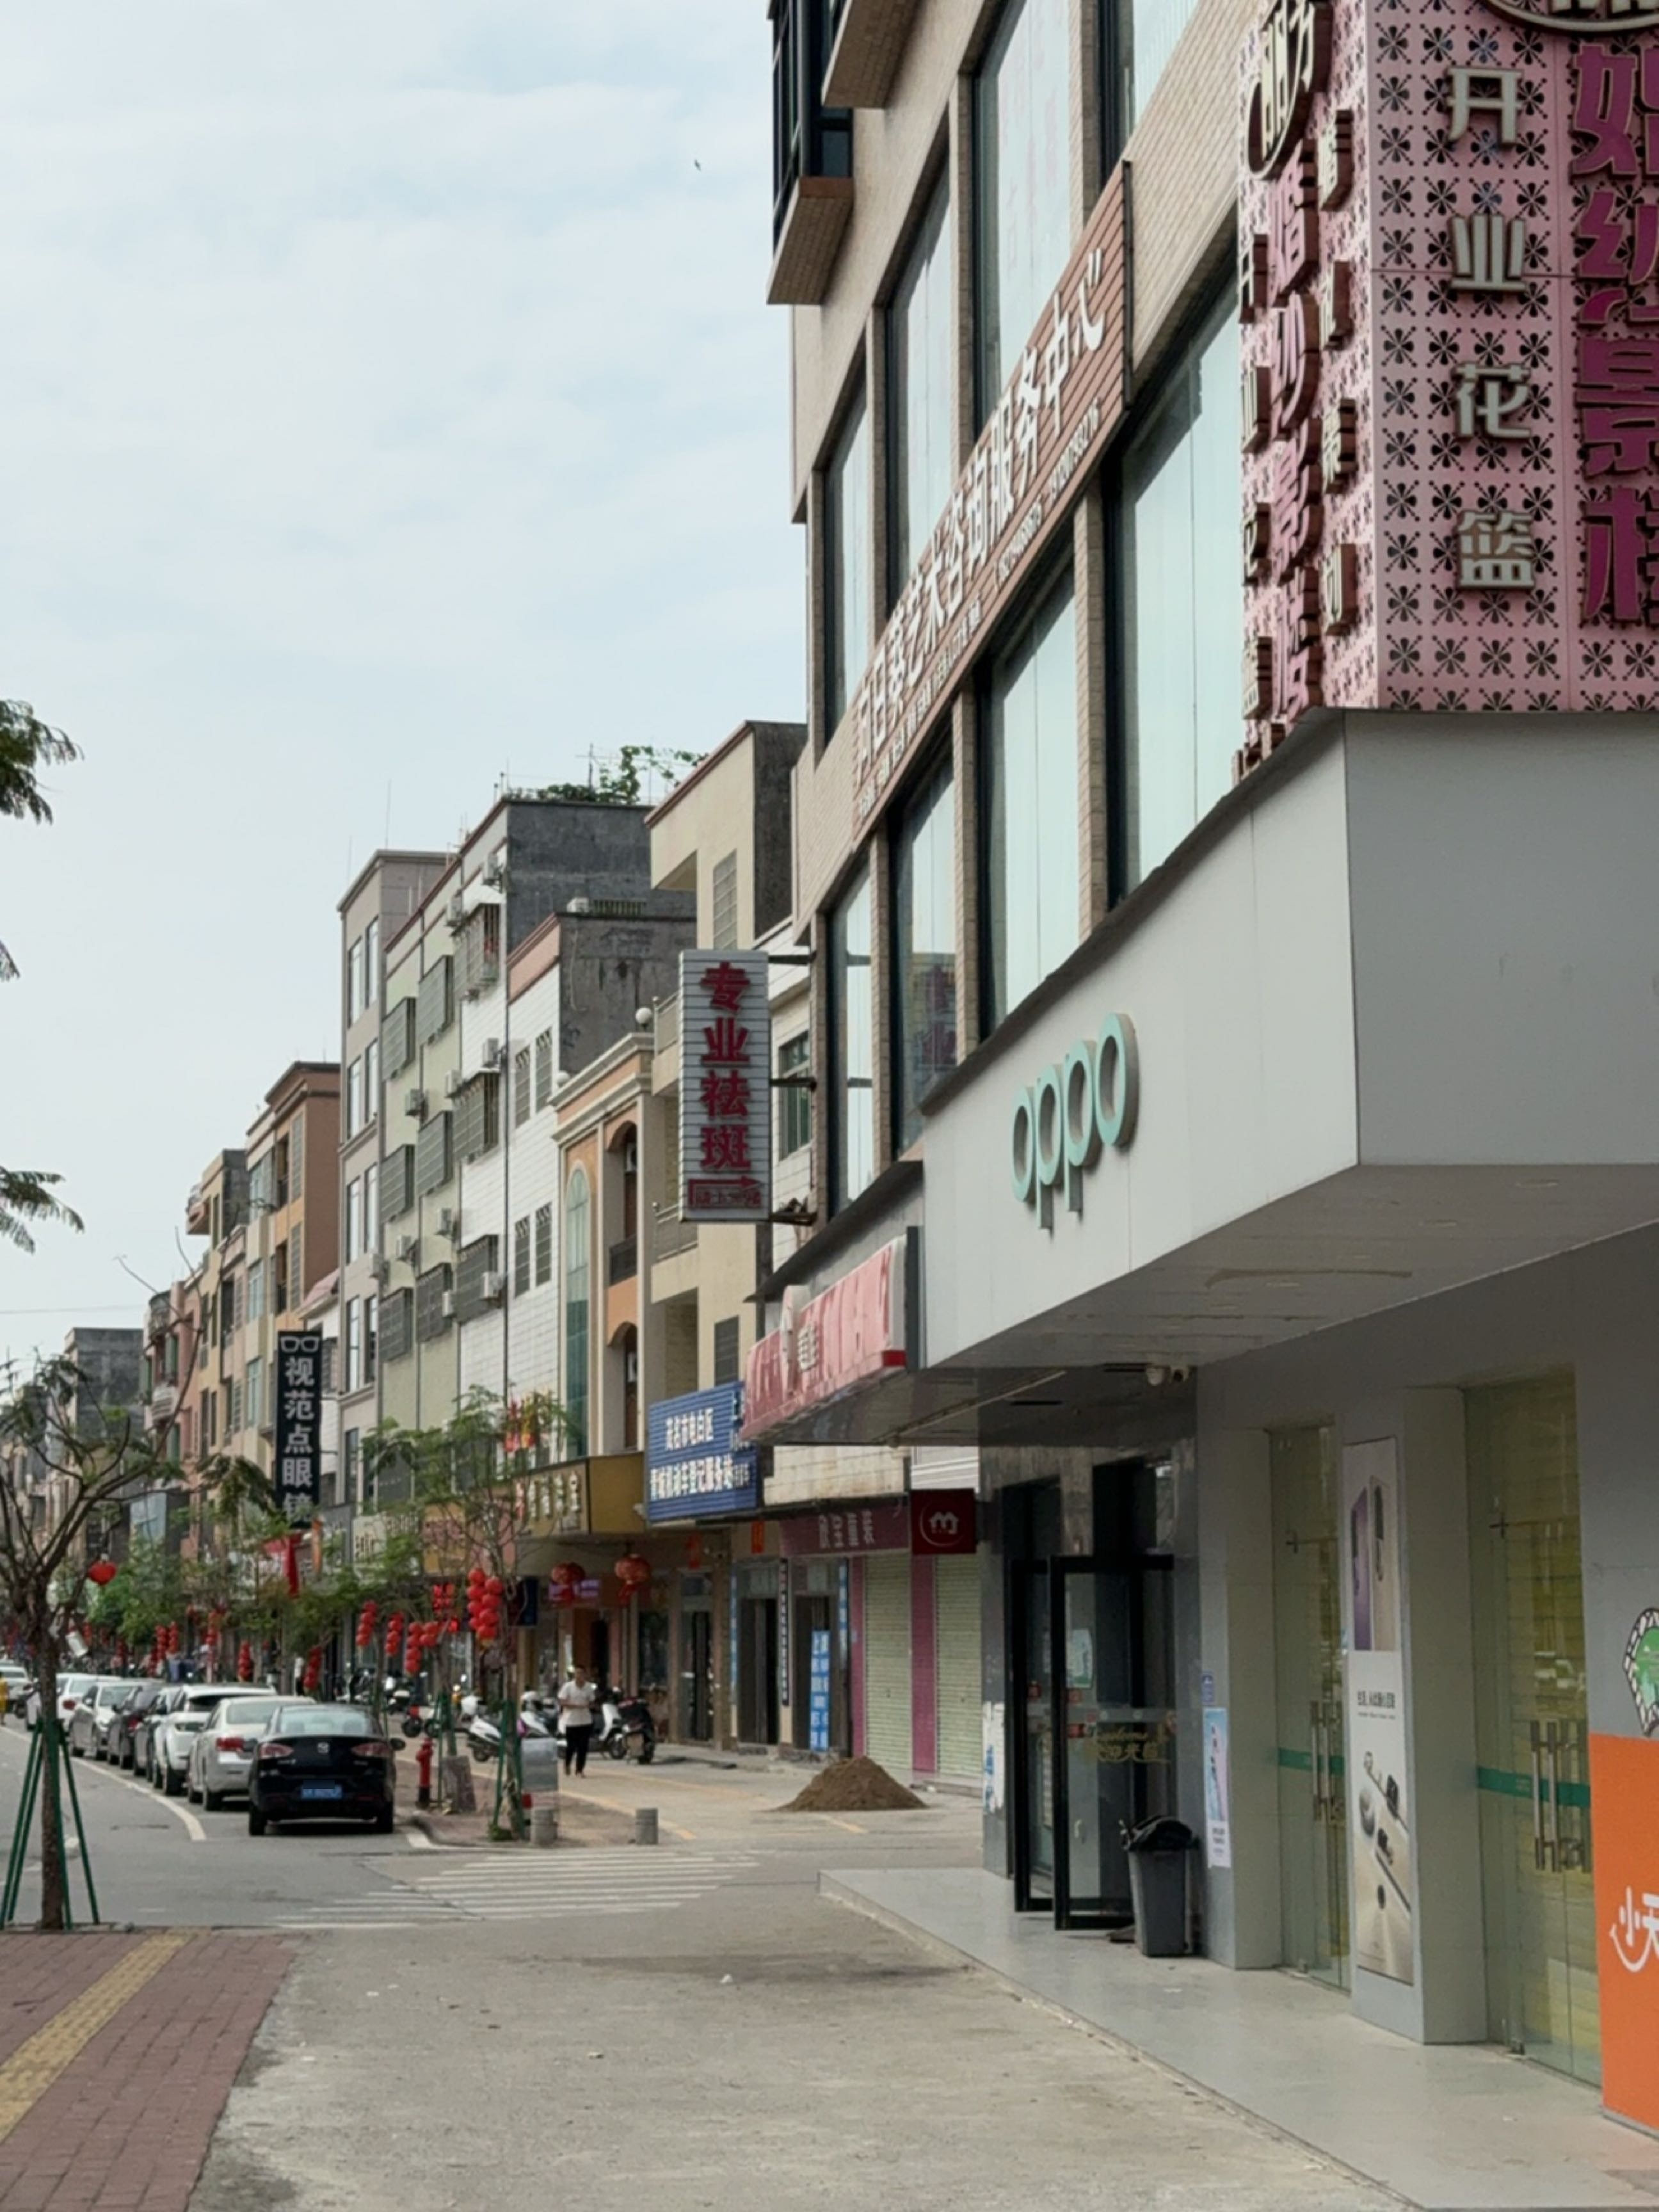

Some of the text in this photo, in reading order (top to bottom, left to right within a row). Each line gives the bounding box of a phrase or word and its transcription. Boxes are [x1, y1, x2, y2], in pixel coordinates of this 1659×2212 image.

[1446, 65, 1535, 590] 开业花篮
[699, 961, 751, 1171] 专业祛斑
[1011, 1012, 1137, 1230] oppo
